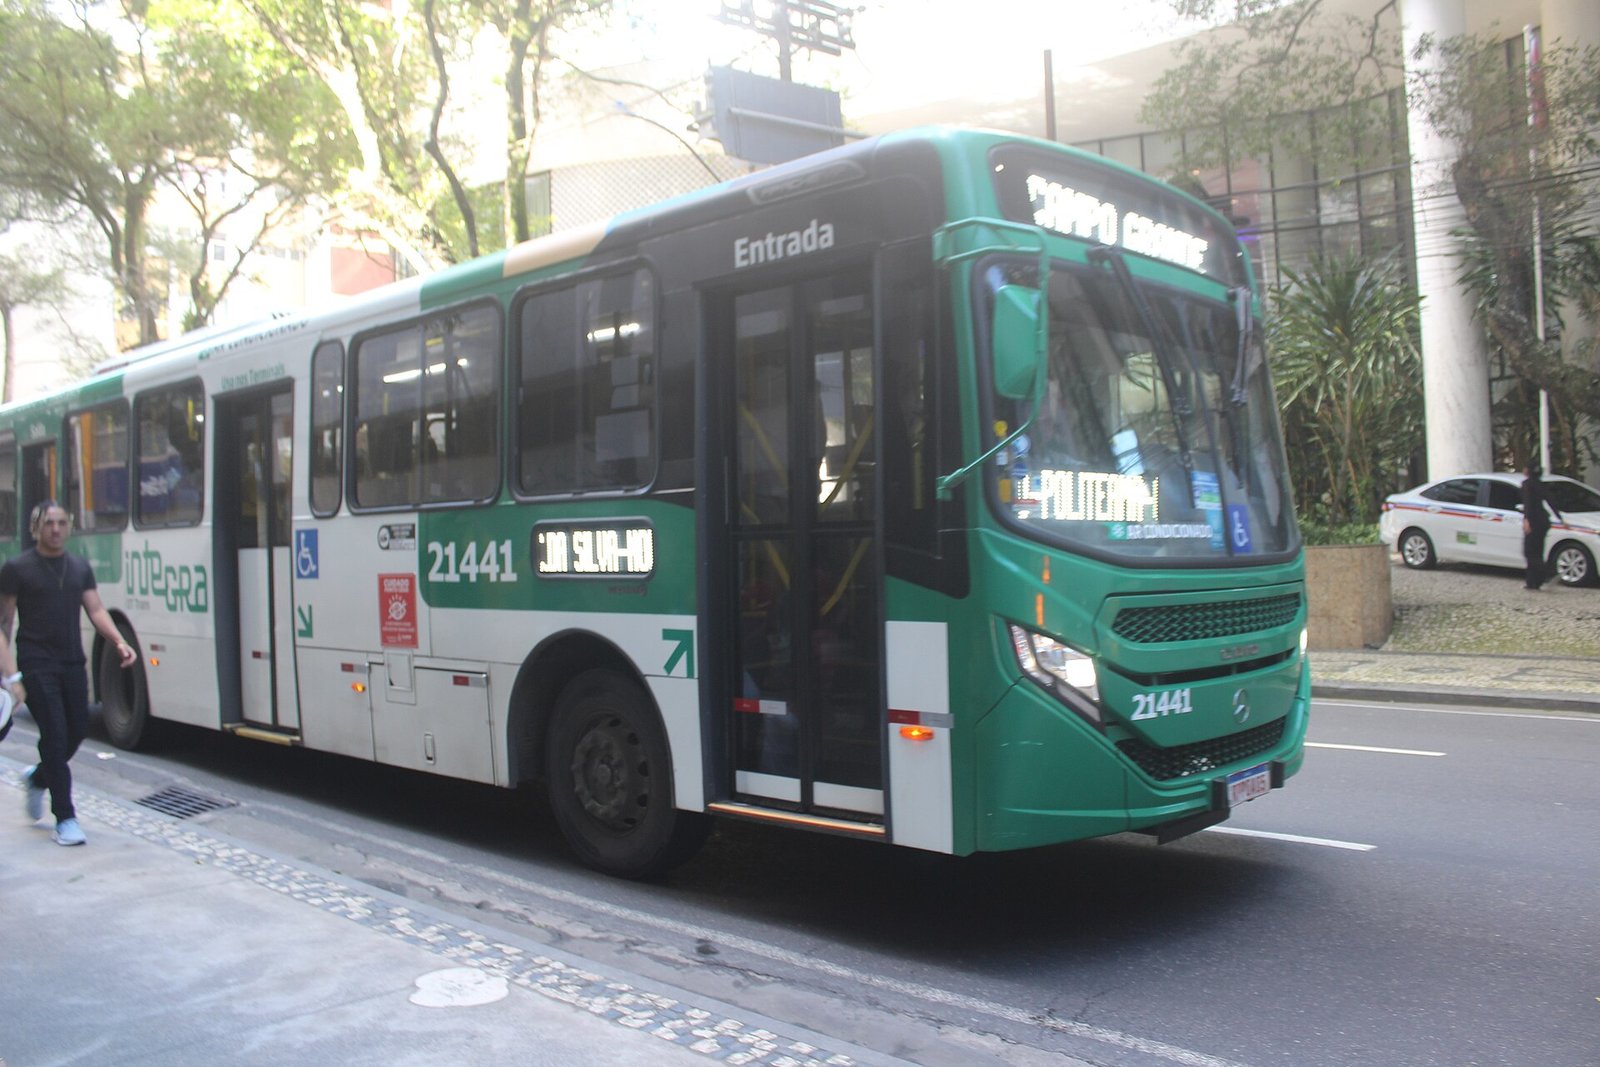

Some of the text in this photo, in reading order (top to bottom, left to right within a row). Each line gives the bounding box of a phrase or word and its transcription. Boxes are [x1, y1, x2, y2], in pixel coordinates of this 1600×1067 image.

[734, 219, 834, 268] Entrada
[427, 539, 518, 583] 21441
[1130, 687, 1193, 721] 21441
